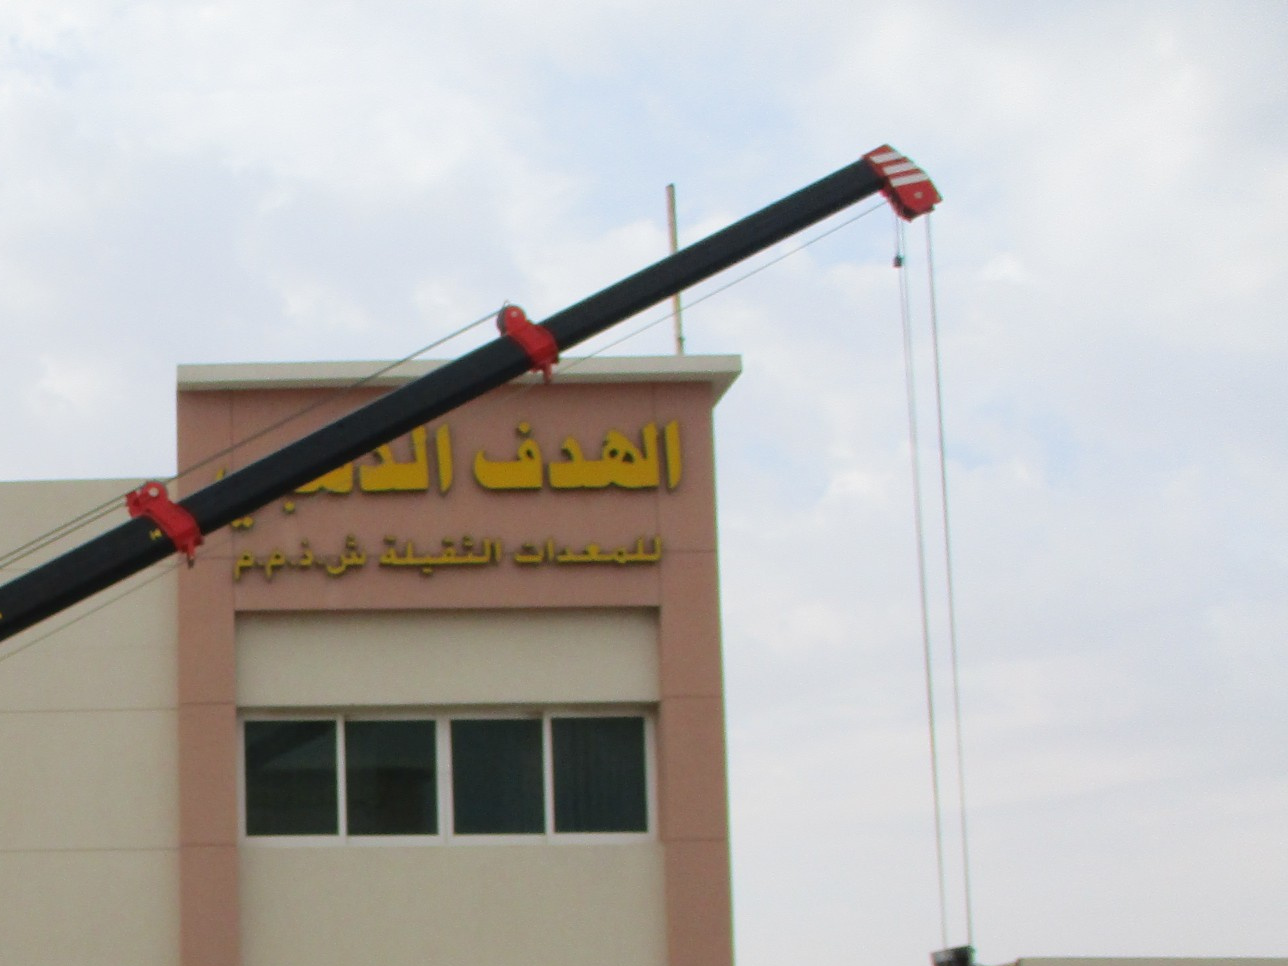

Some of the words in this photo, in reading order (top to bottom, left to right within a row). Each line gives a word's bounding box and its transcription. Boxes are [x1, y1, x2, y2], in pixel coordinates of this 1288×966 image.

[473, 420, 683, 493] الهدف
[378, 535, 502, 576] الثقيلة
[514, 535, 663, 566] للمعدات
